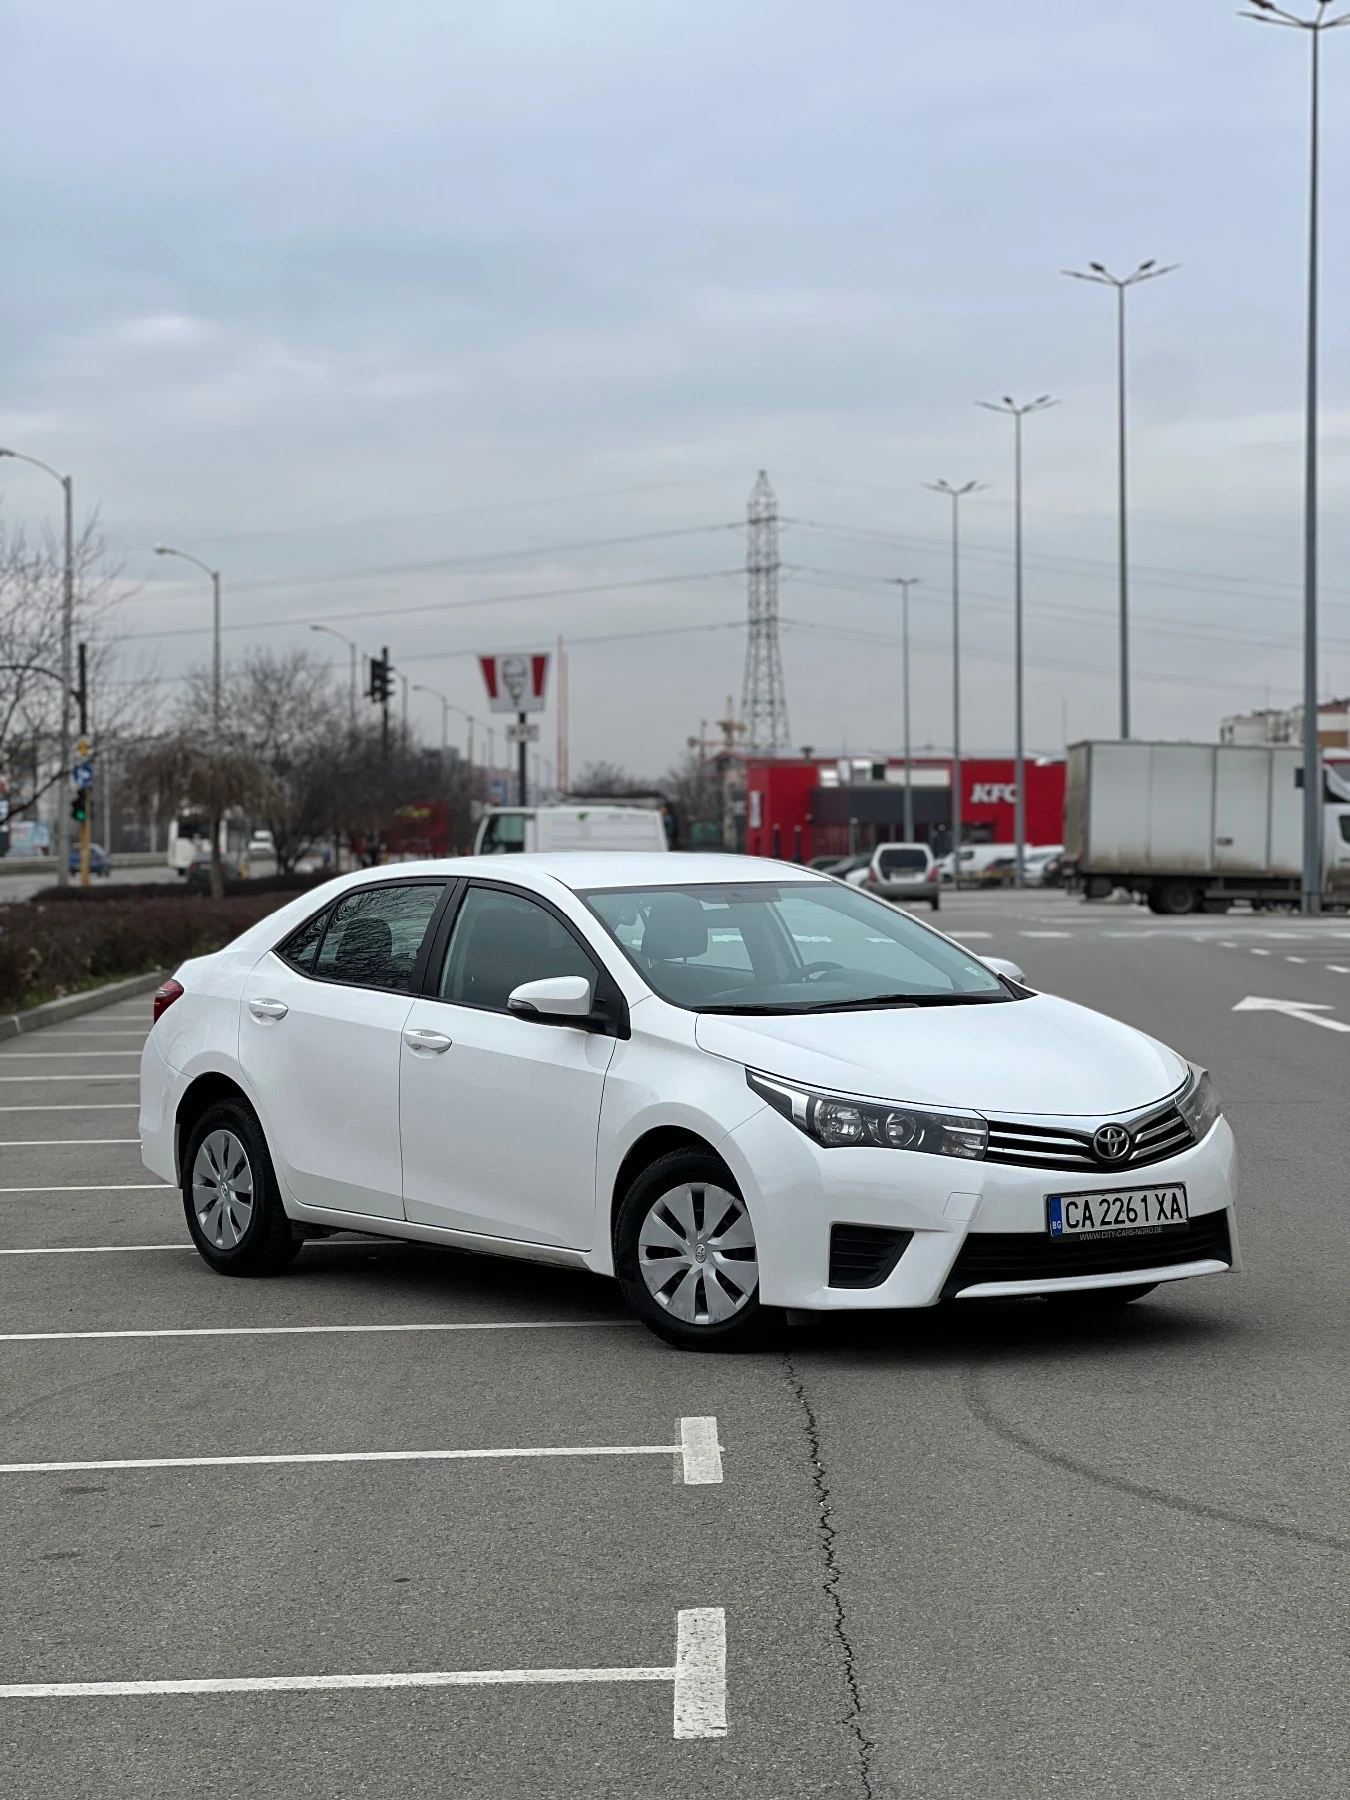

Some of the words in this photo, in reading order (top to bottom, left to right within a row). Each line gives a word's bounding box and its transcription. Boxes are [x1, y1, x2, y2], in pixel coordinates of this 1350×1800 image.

[970, 783, 1017, 804] KFC
[1065, 1199, 1095, 1229] CA
[1099, 1194, 1150, 1227] 2261
[1155, 1191, 1183, 1221] XA
[1052, 1220, 1062, 1230] BG
